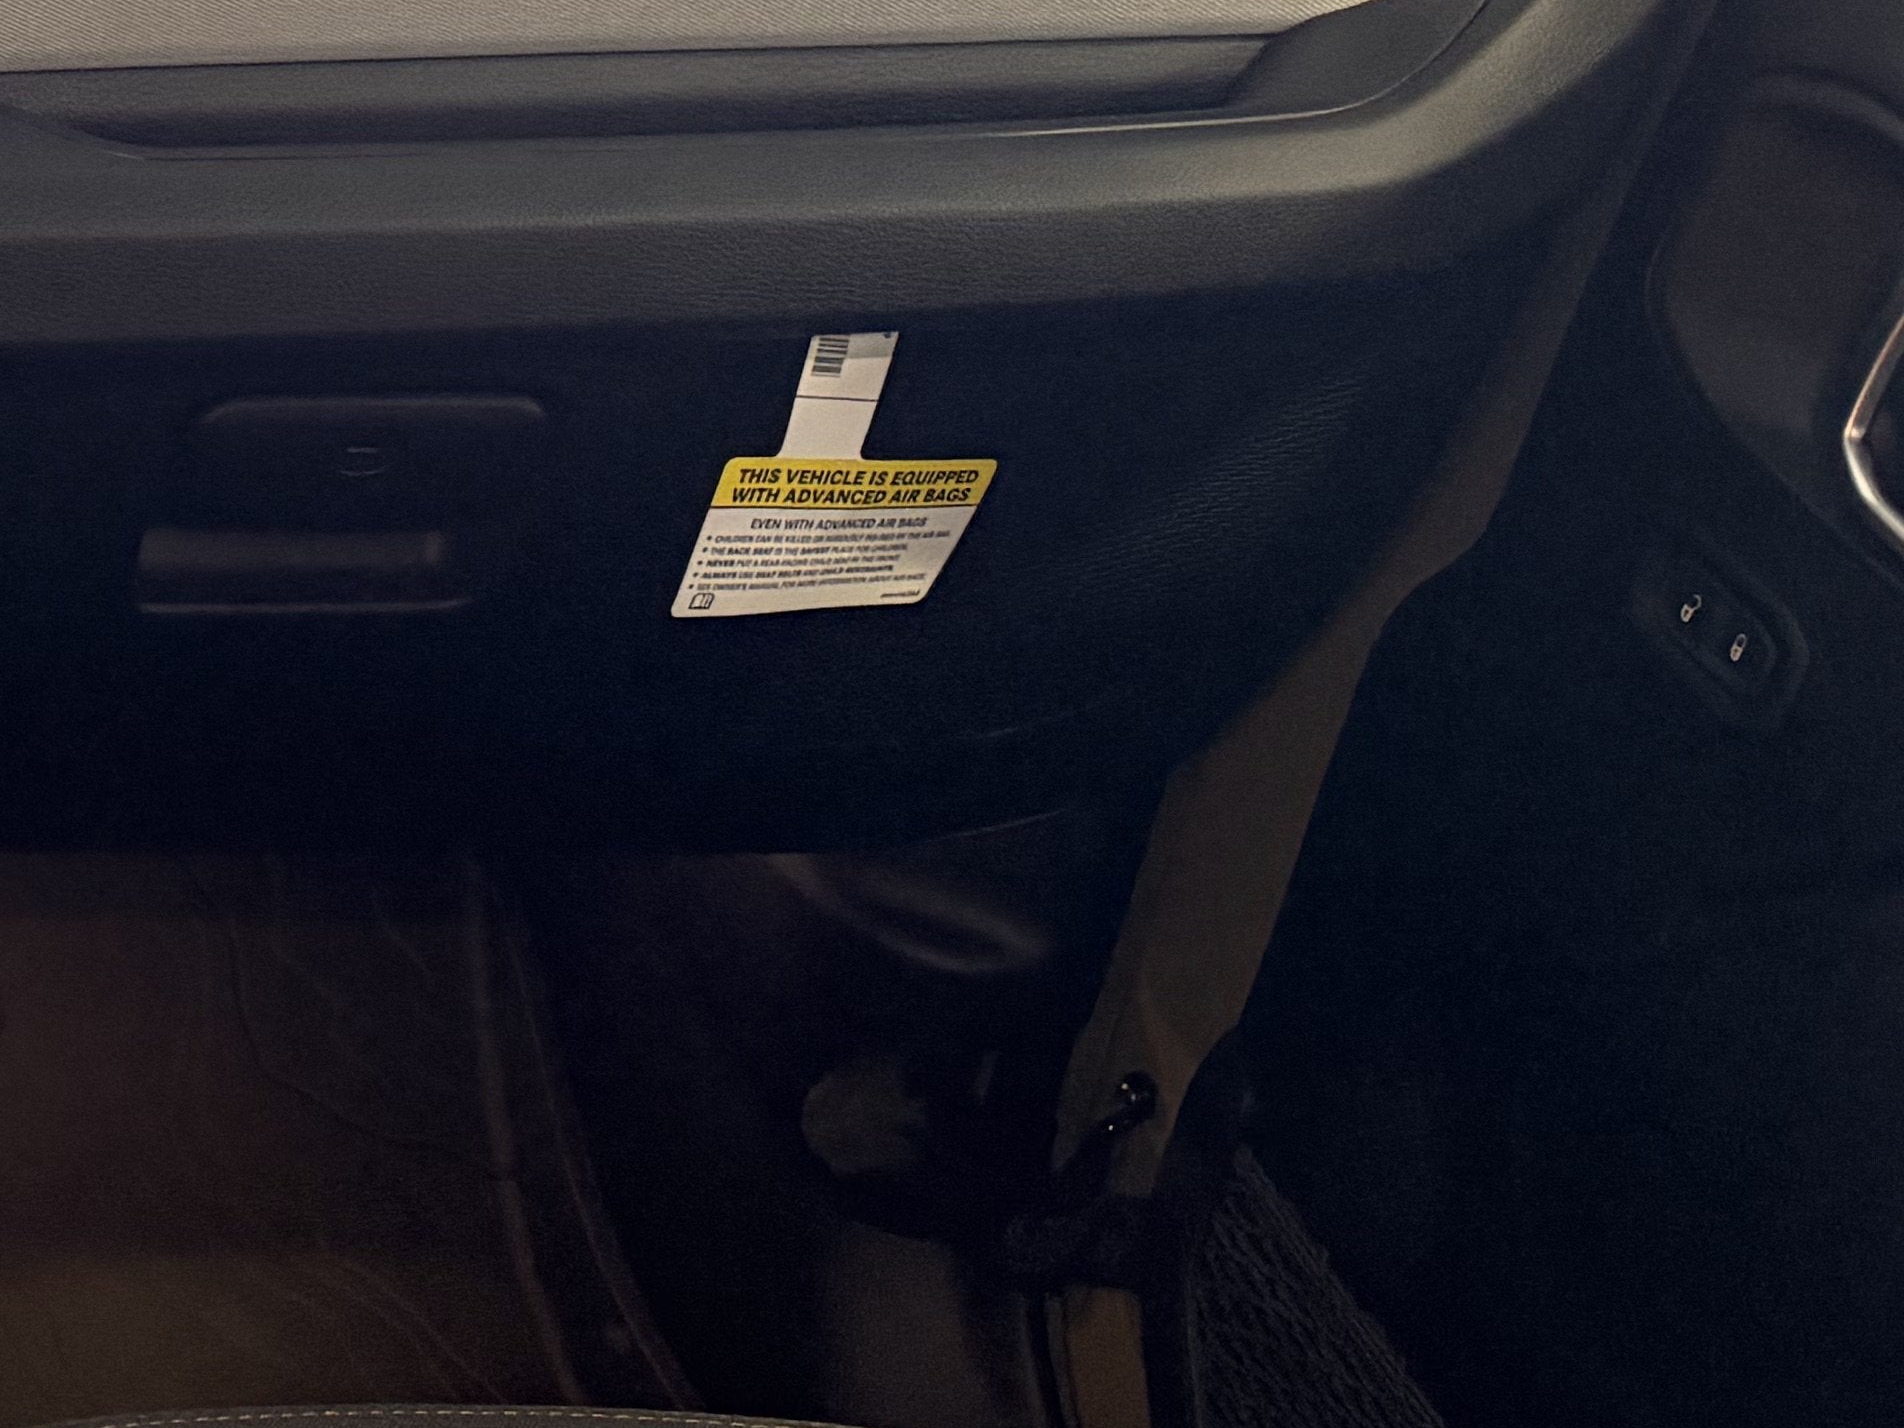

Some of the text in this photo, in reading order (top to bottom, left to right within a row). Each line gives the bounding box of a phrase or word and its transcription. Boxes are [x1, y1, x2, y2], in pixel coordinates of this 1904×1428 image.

[739, 468, 979, 485] THIS VEHICLE IS EQUIPPED
[731, 487, 971, 504] WITH ADVANCED AIR BAGS
[750, 518, 782, 530] EVEN
[784, 519, 814, 530] WITH
[816, 518, 877, 530] ADVANCED
